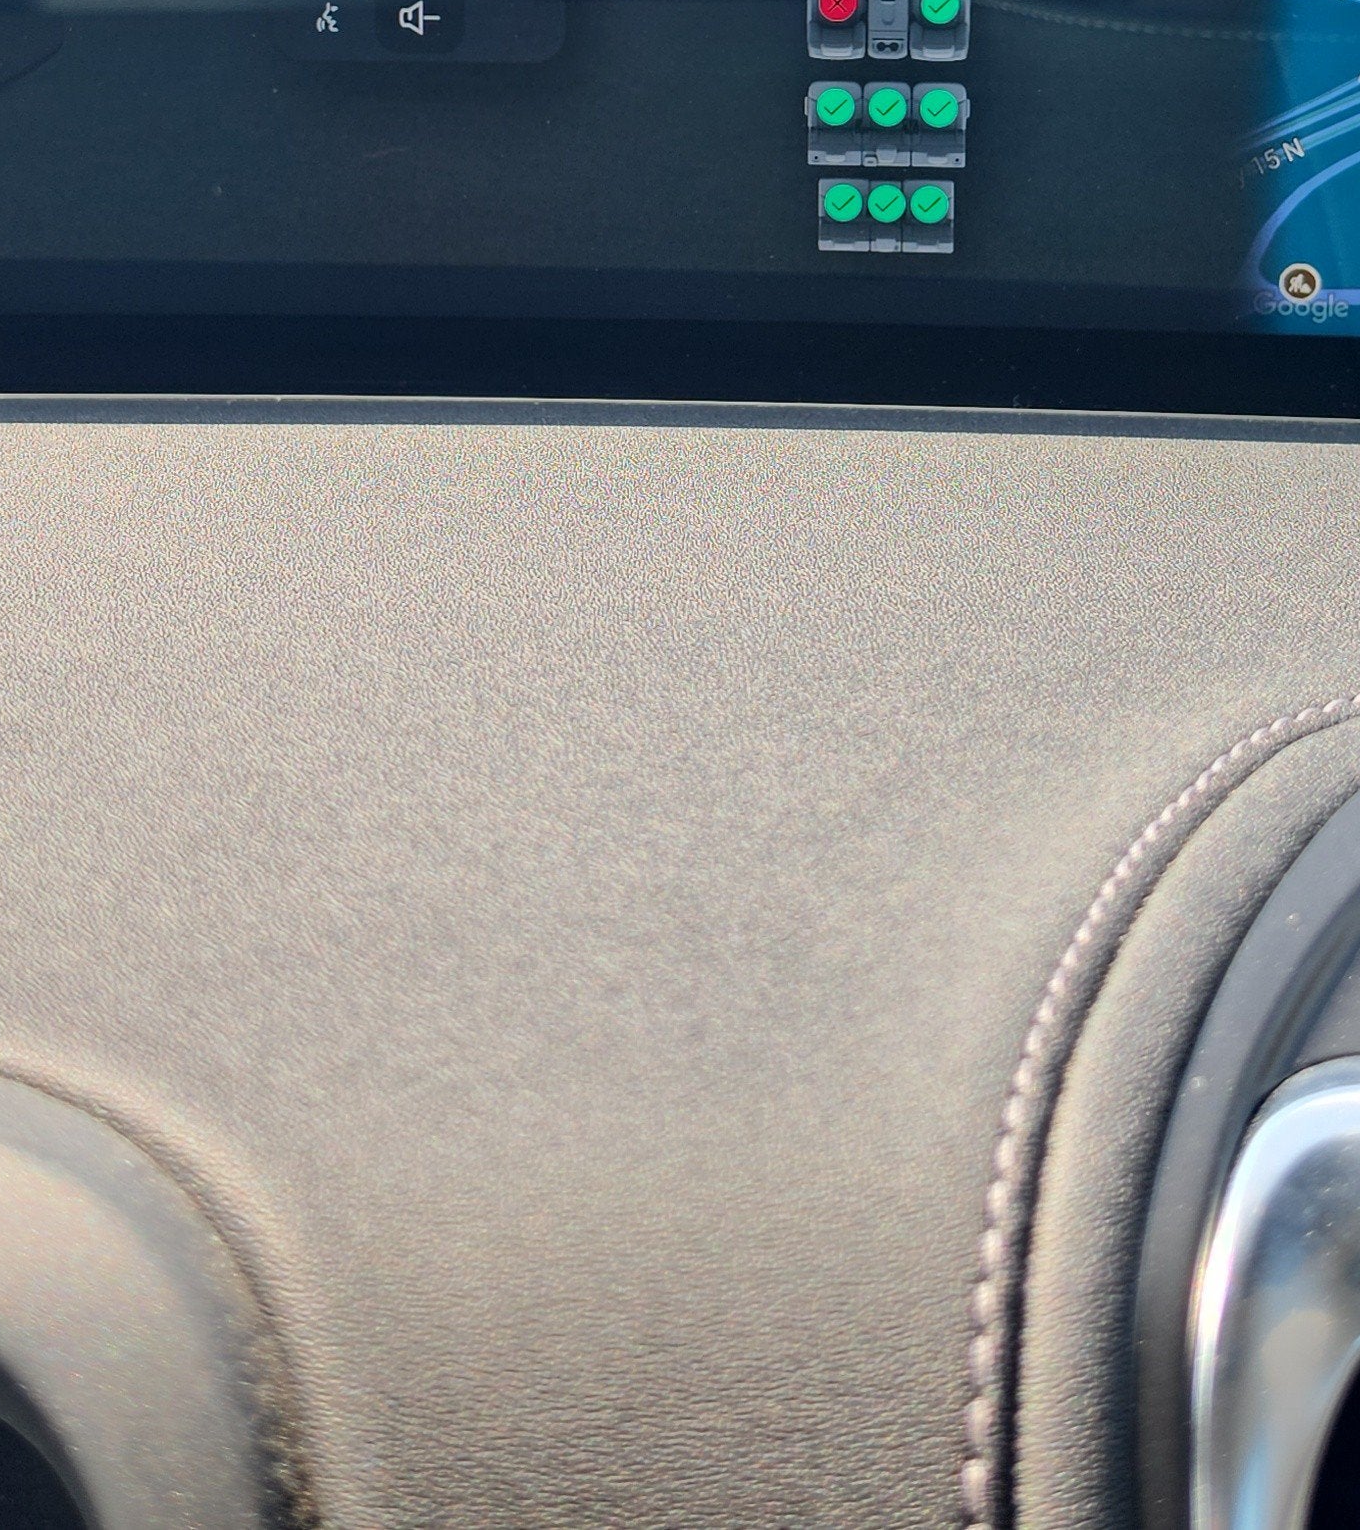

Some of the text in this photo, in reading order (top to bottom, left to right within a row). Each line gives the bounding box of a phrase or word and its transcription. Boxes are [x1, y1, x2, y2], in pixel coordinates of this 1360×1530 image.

[1251, 137, 1305, 174] 15 N
[1254, 291, 1349, 324] Google
